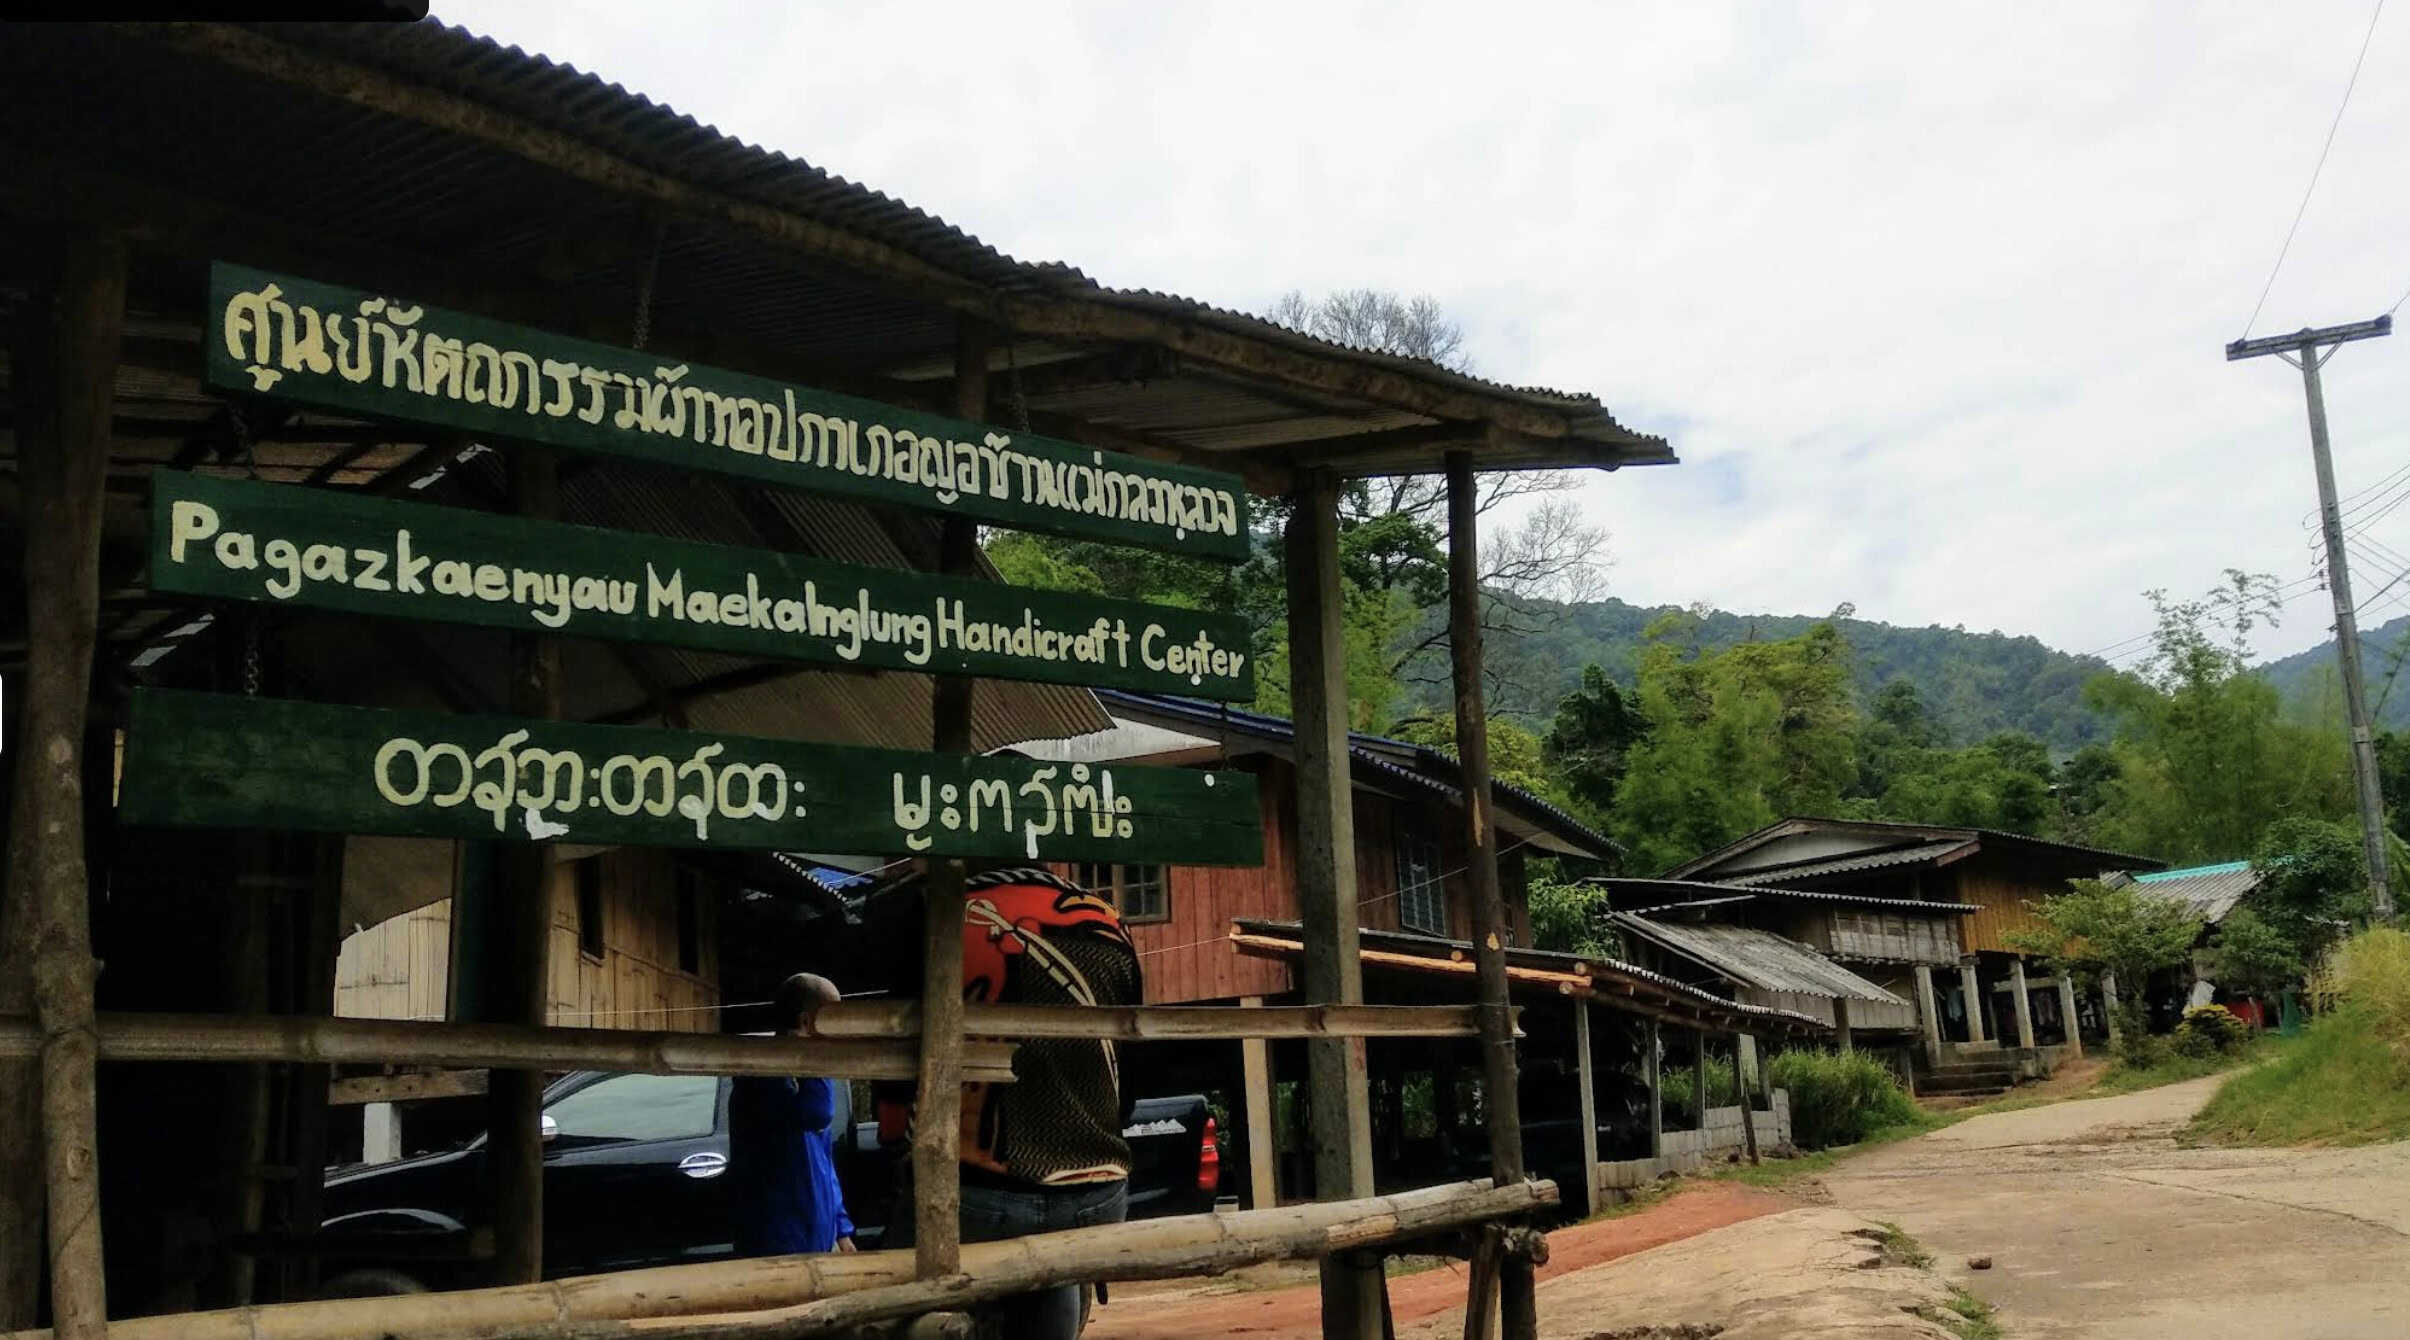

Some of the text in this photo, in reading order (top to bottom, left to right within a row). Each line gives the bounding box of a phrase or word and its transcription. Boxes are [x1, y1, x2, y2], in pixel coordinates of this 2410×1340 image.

[170, 500, 638, 628] Pagazkaenyau
[936, 597, 1131, 668] Handicraft
[1140, 623, 1245, 678] Center
